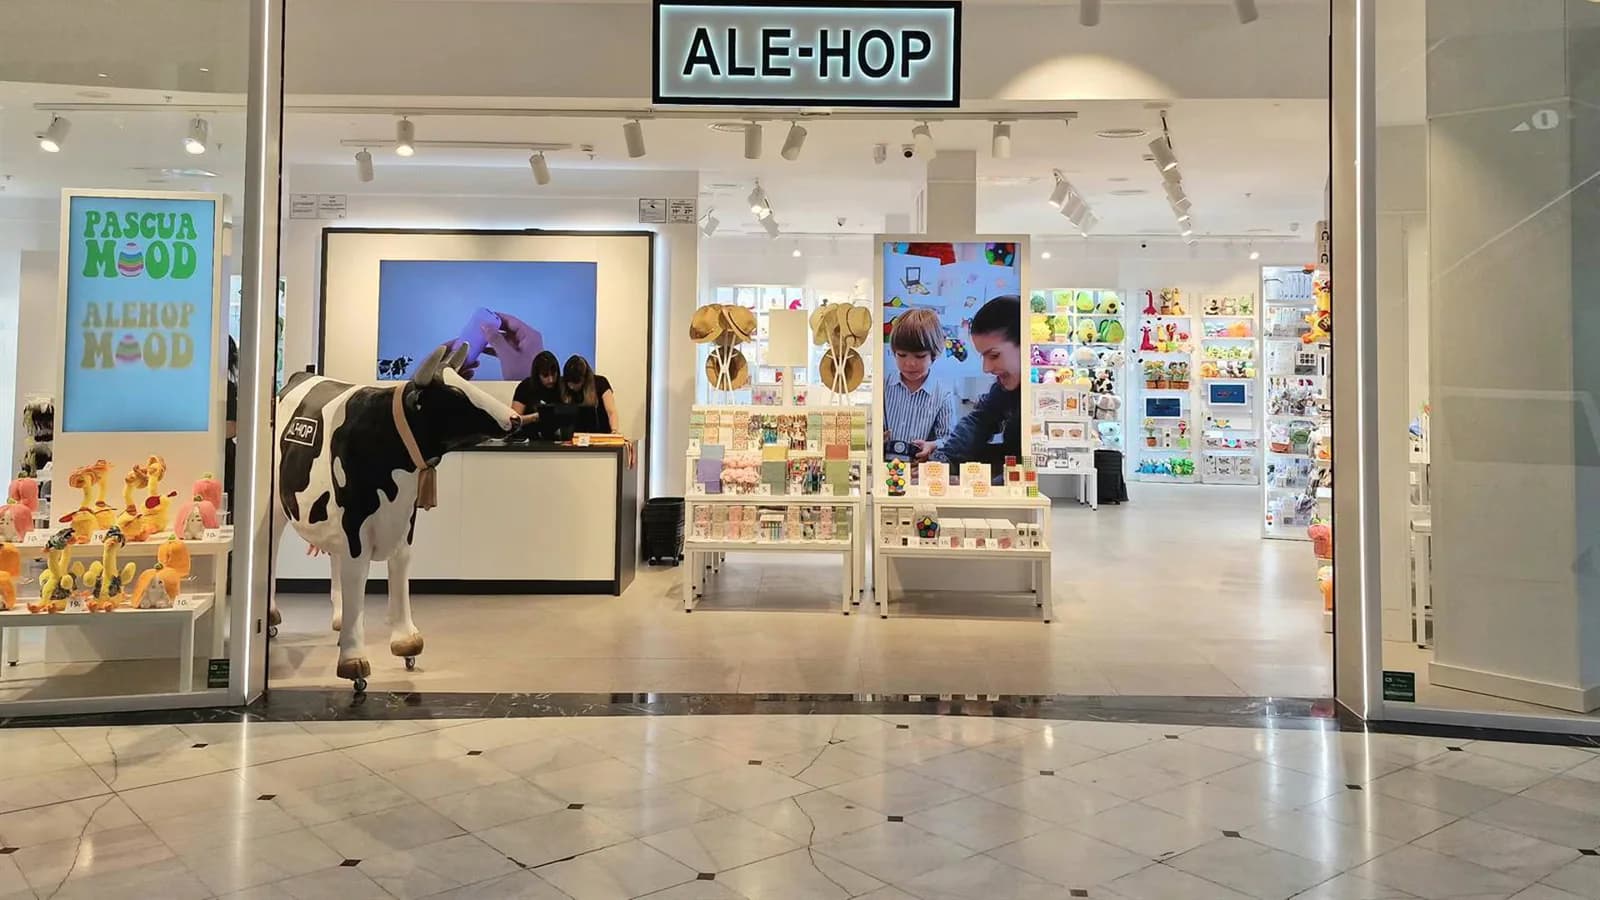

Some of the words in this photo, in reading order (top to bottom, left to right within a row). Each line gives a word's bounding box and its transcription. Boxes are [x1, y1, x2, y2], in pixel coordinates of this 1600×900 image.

[682, 27, 932, 79] ALE-HOP
[83, 210, 198, 240] PASCUA
[82, 300, 196, 330] ALEHOP
